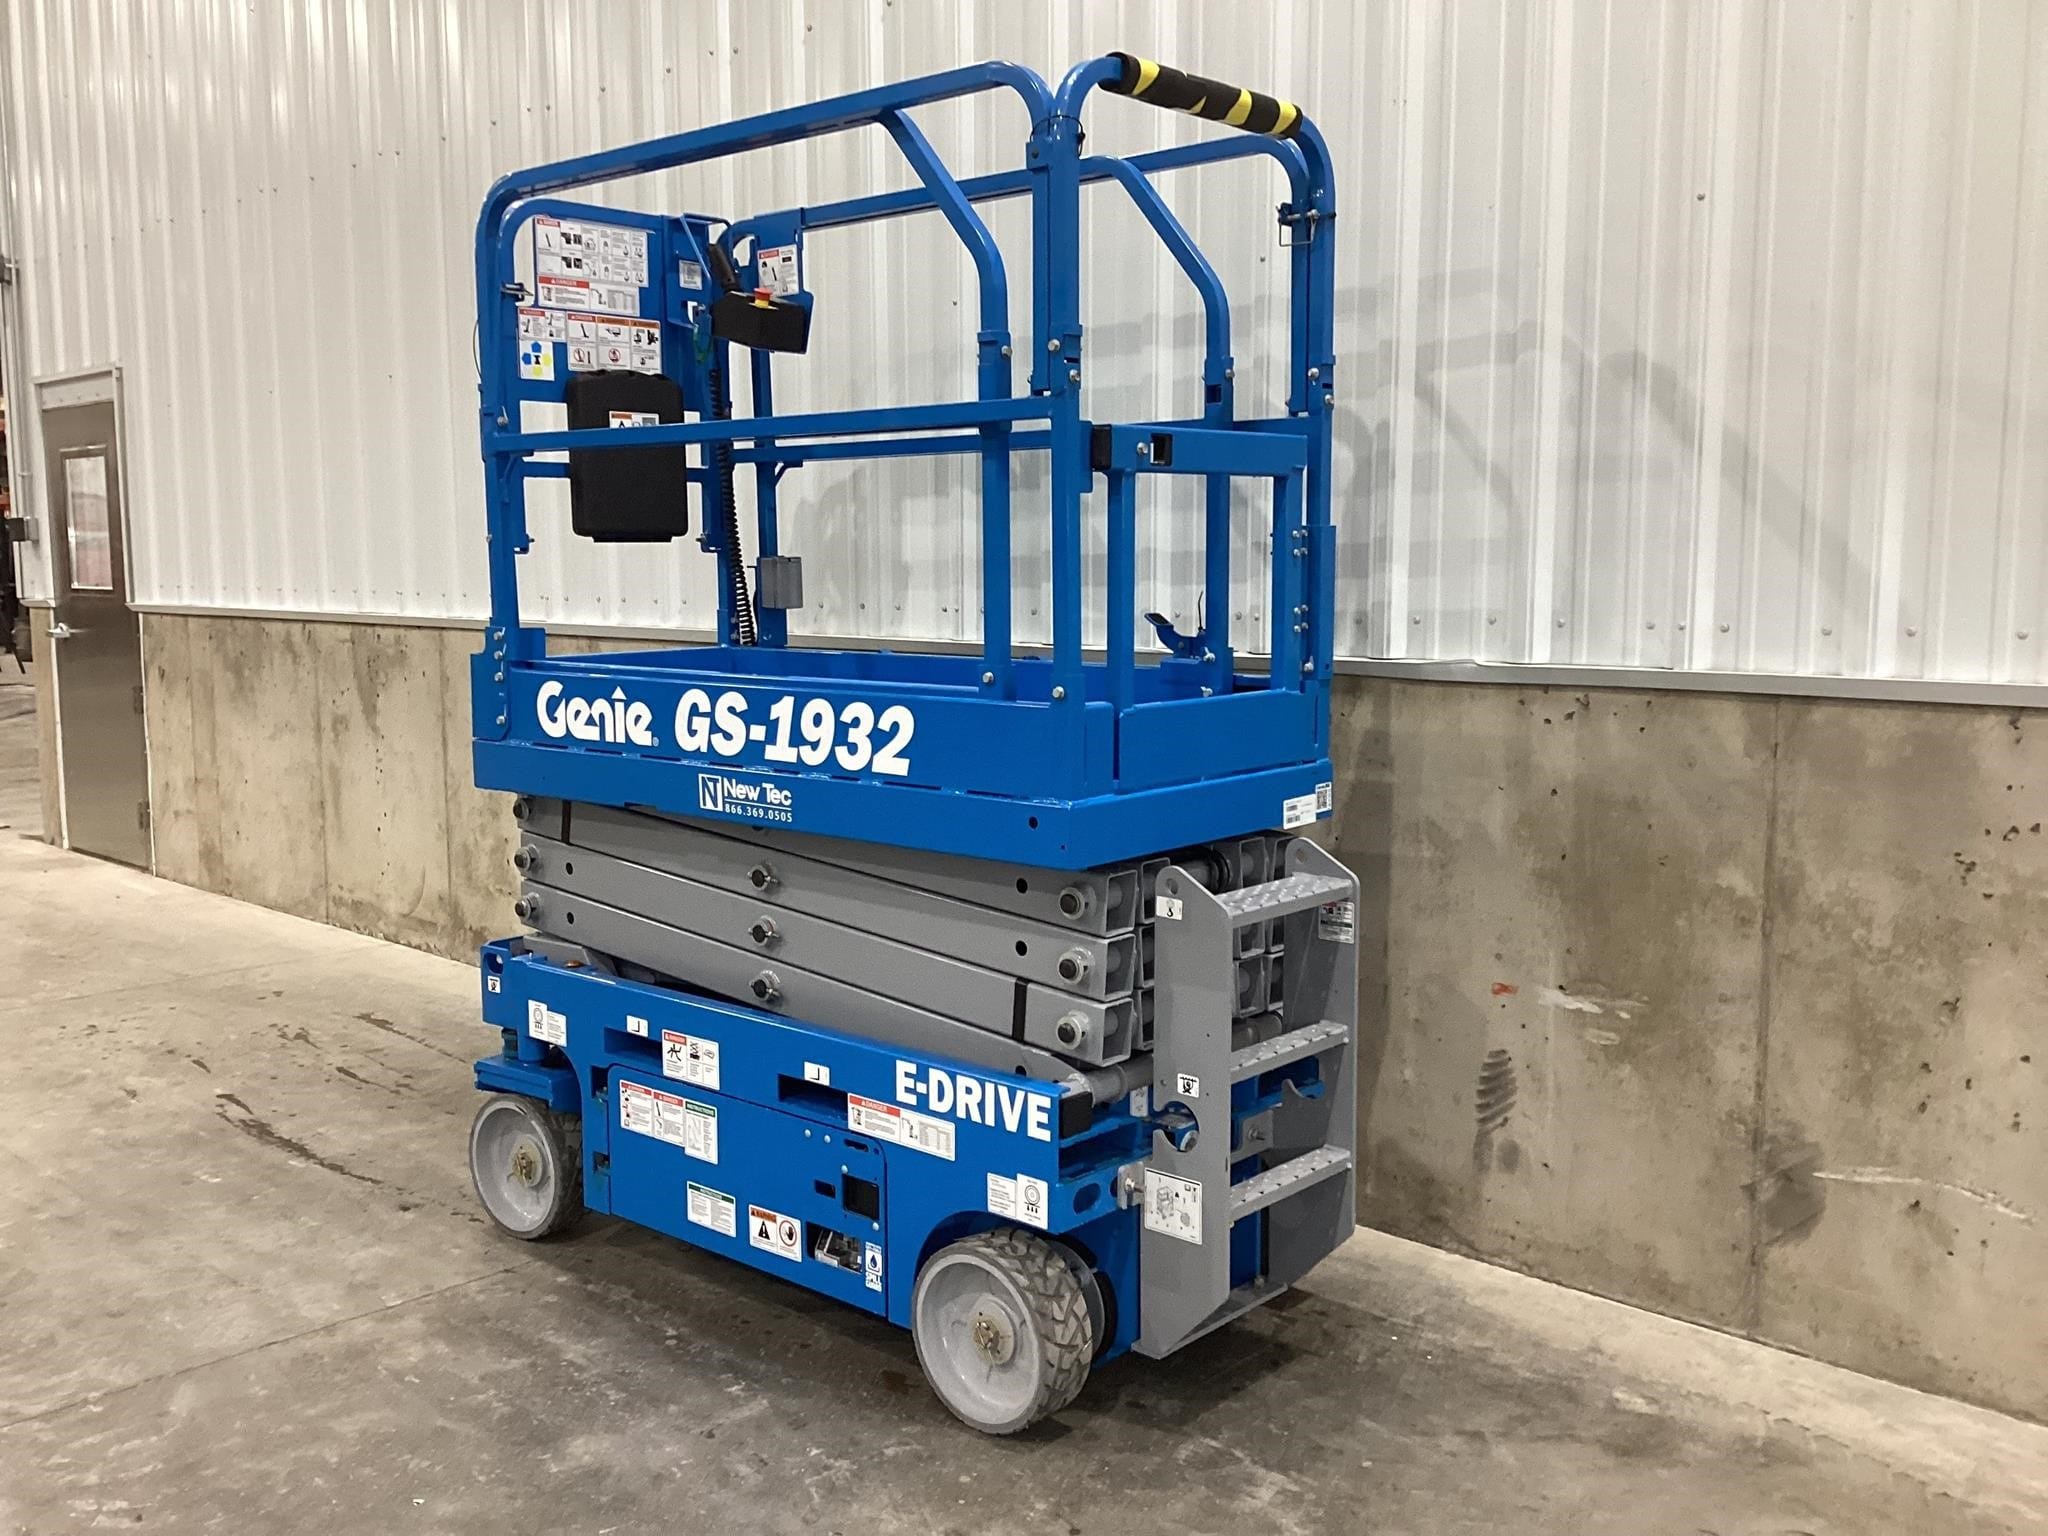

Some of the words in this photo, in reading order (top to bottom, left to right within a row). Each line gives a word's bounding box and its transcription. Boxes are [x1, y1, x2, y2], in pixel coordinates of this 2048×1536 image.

[536, 680, 653, 747] Genie
[675, 688, 915, 776] GS-1932
[723, 777, 760, 801] New
[762, 782, 792, 806] Tec
[725, 803, 793, 823] 866.369.0505
[895, 1059, 1052, 1143] E-DRIVE
